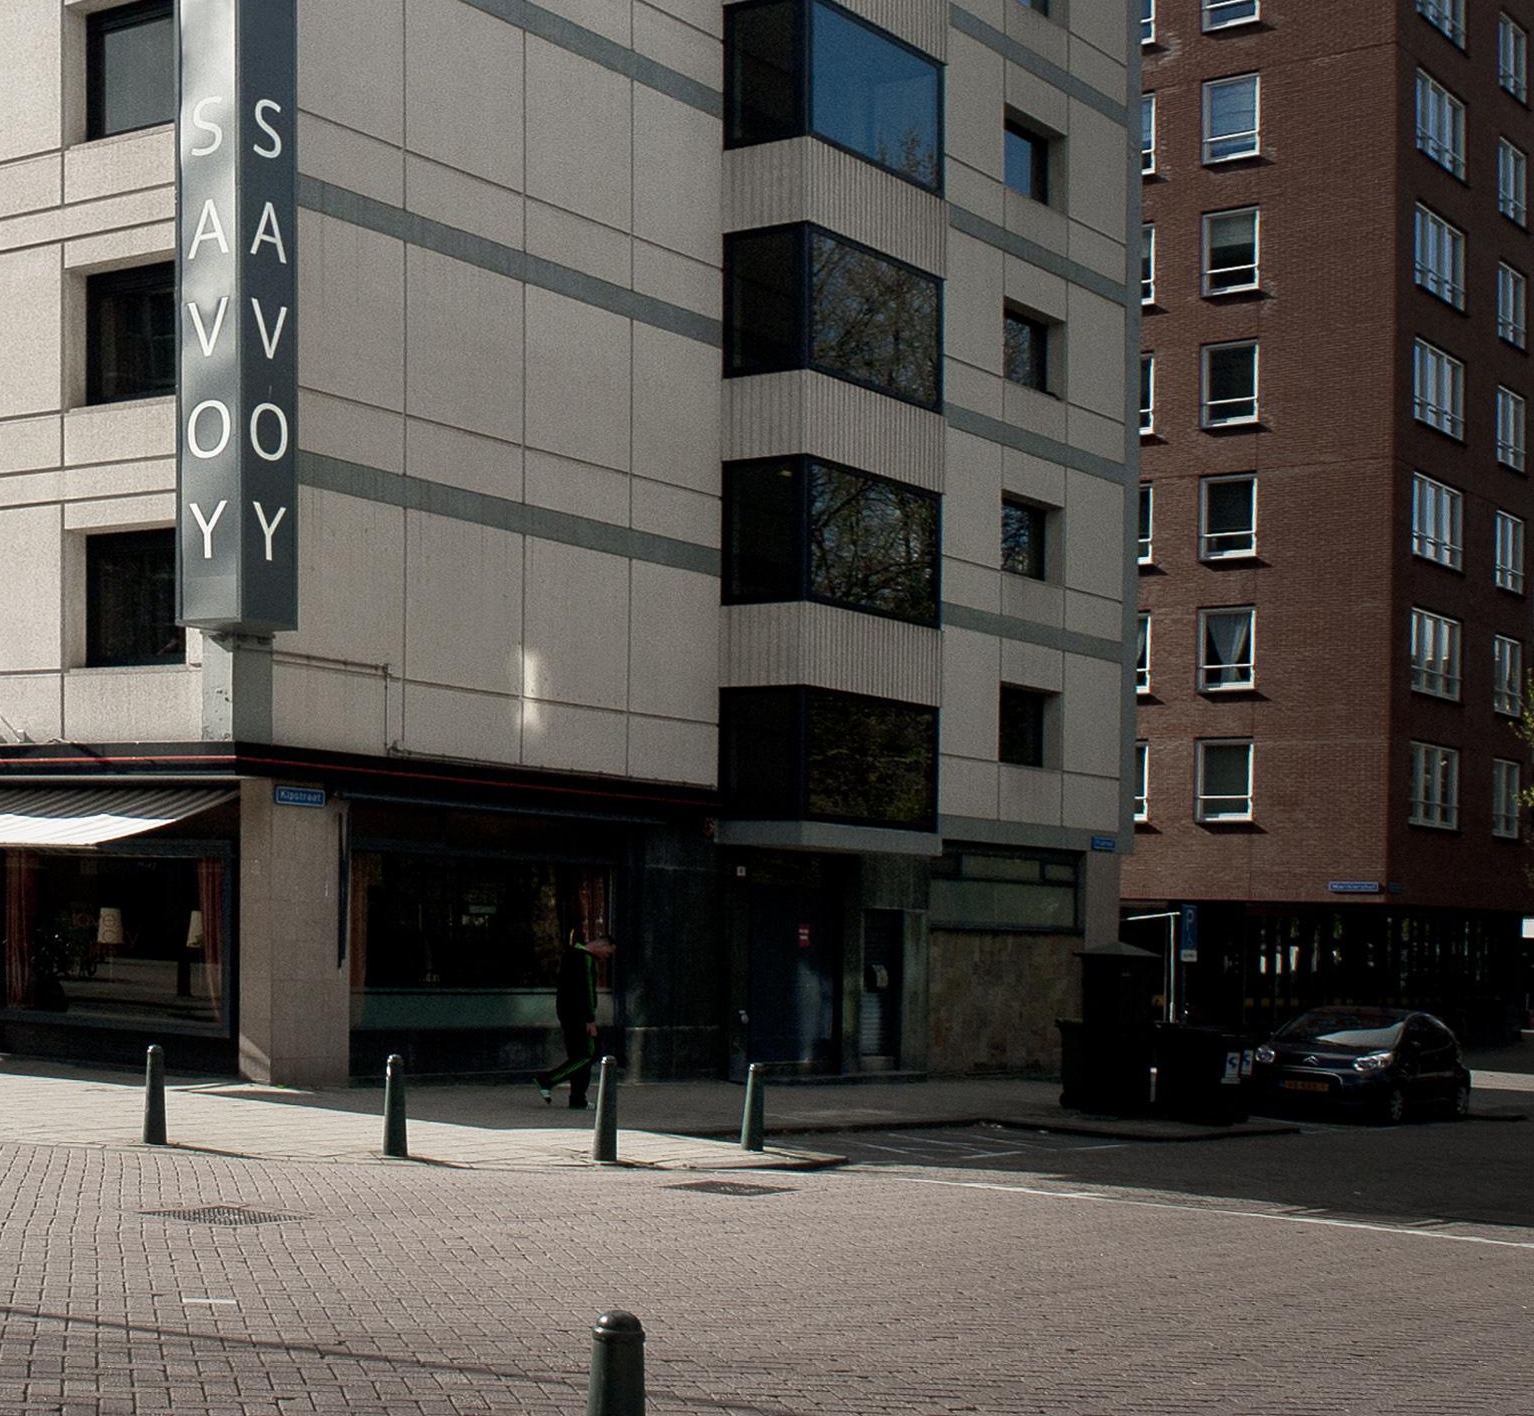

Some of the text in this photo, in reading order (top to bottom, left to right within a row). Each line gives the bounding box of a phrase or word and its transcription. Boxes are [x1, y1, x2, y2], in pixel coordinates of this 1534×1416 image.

[186, 96, 232, 559] SAVOY
[250, 99, 288, 561] SAVOY
[280, 791, 322, 802] Kipstraat
